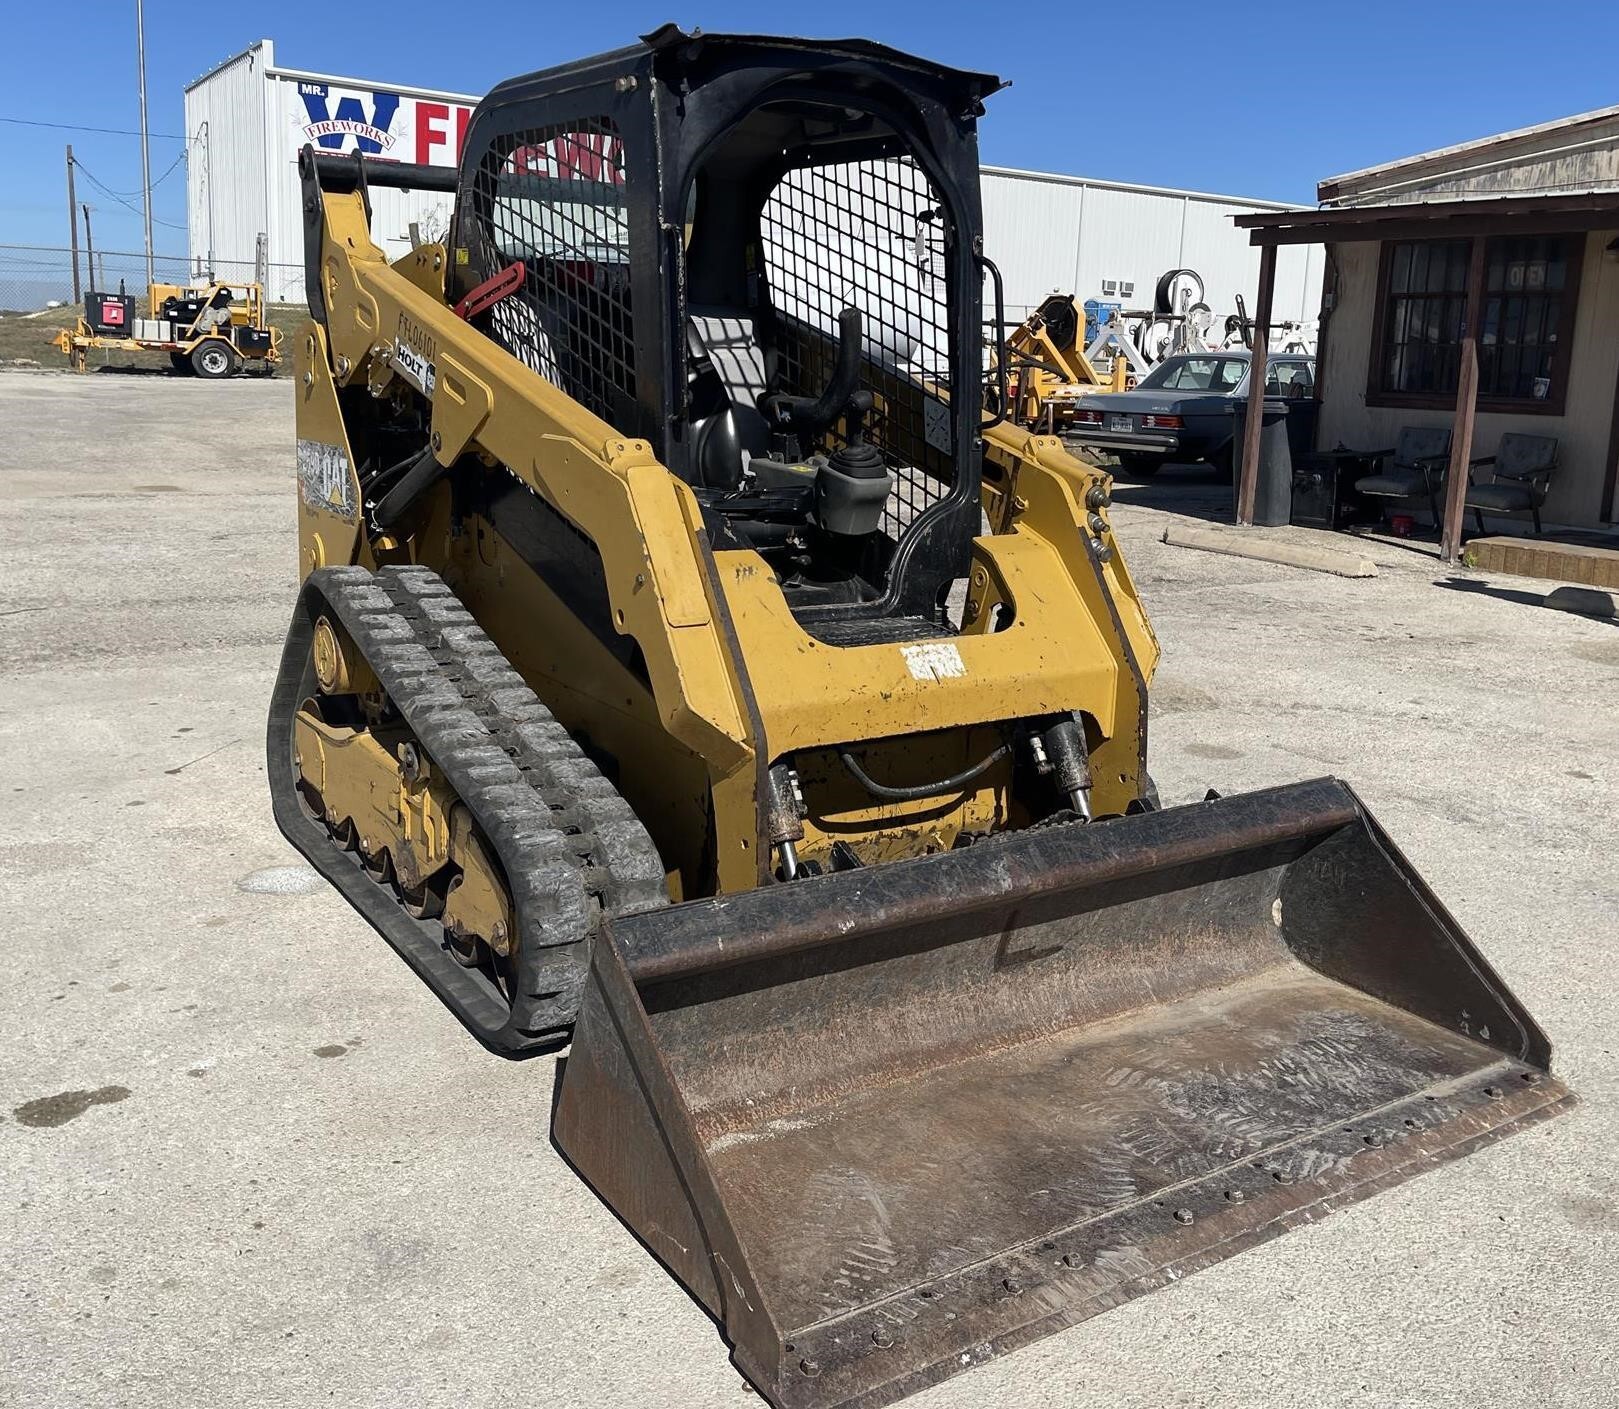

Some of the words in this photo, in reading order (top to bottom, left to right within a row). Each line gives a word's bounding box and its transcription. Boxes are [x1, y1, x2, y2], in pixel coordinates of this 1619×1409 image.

[302, 84, 325, 96] MR.
[298, 82, 399, 154] W
[307, 121, 392, 147] FIREWORKS
[397, 347, 423, 376] HOLT
[322, 452, 348, 507] CAT
